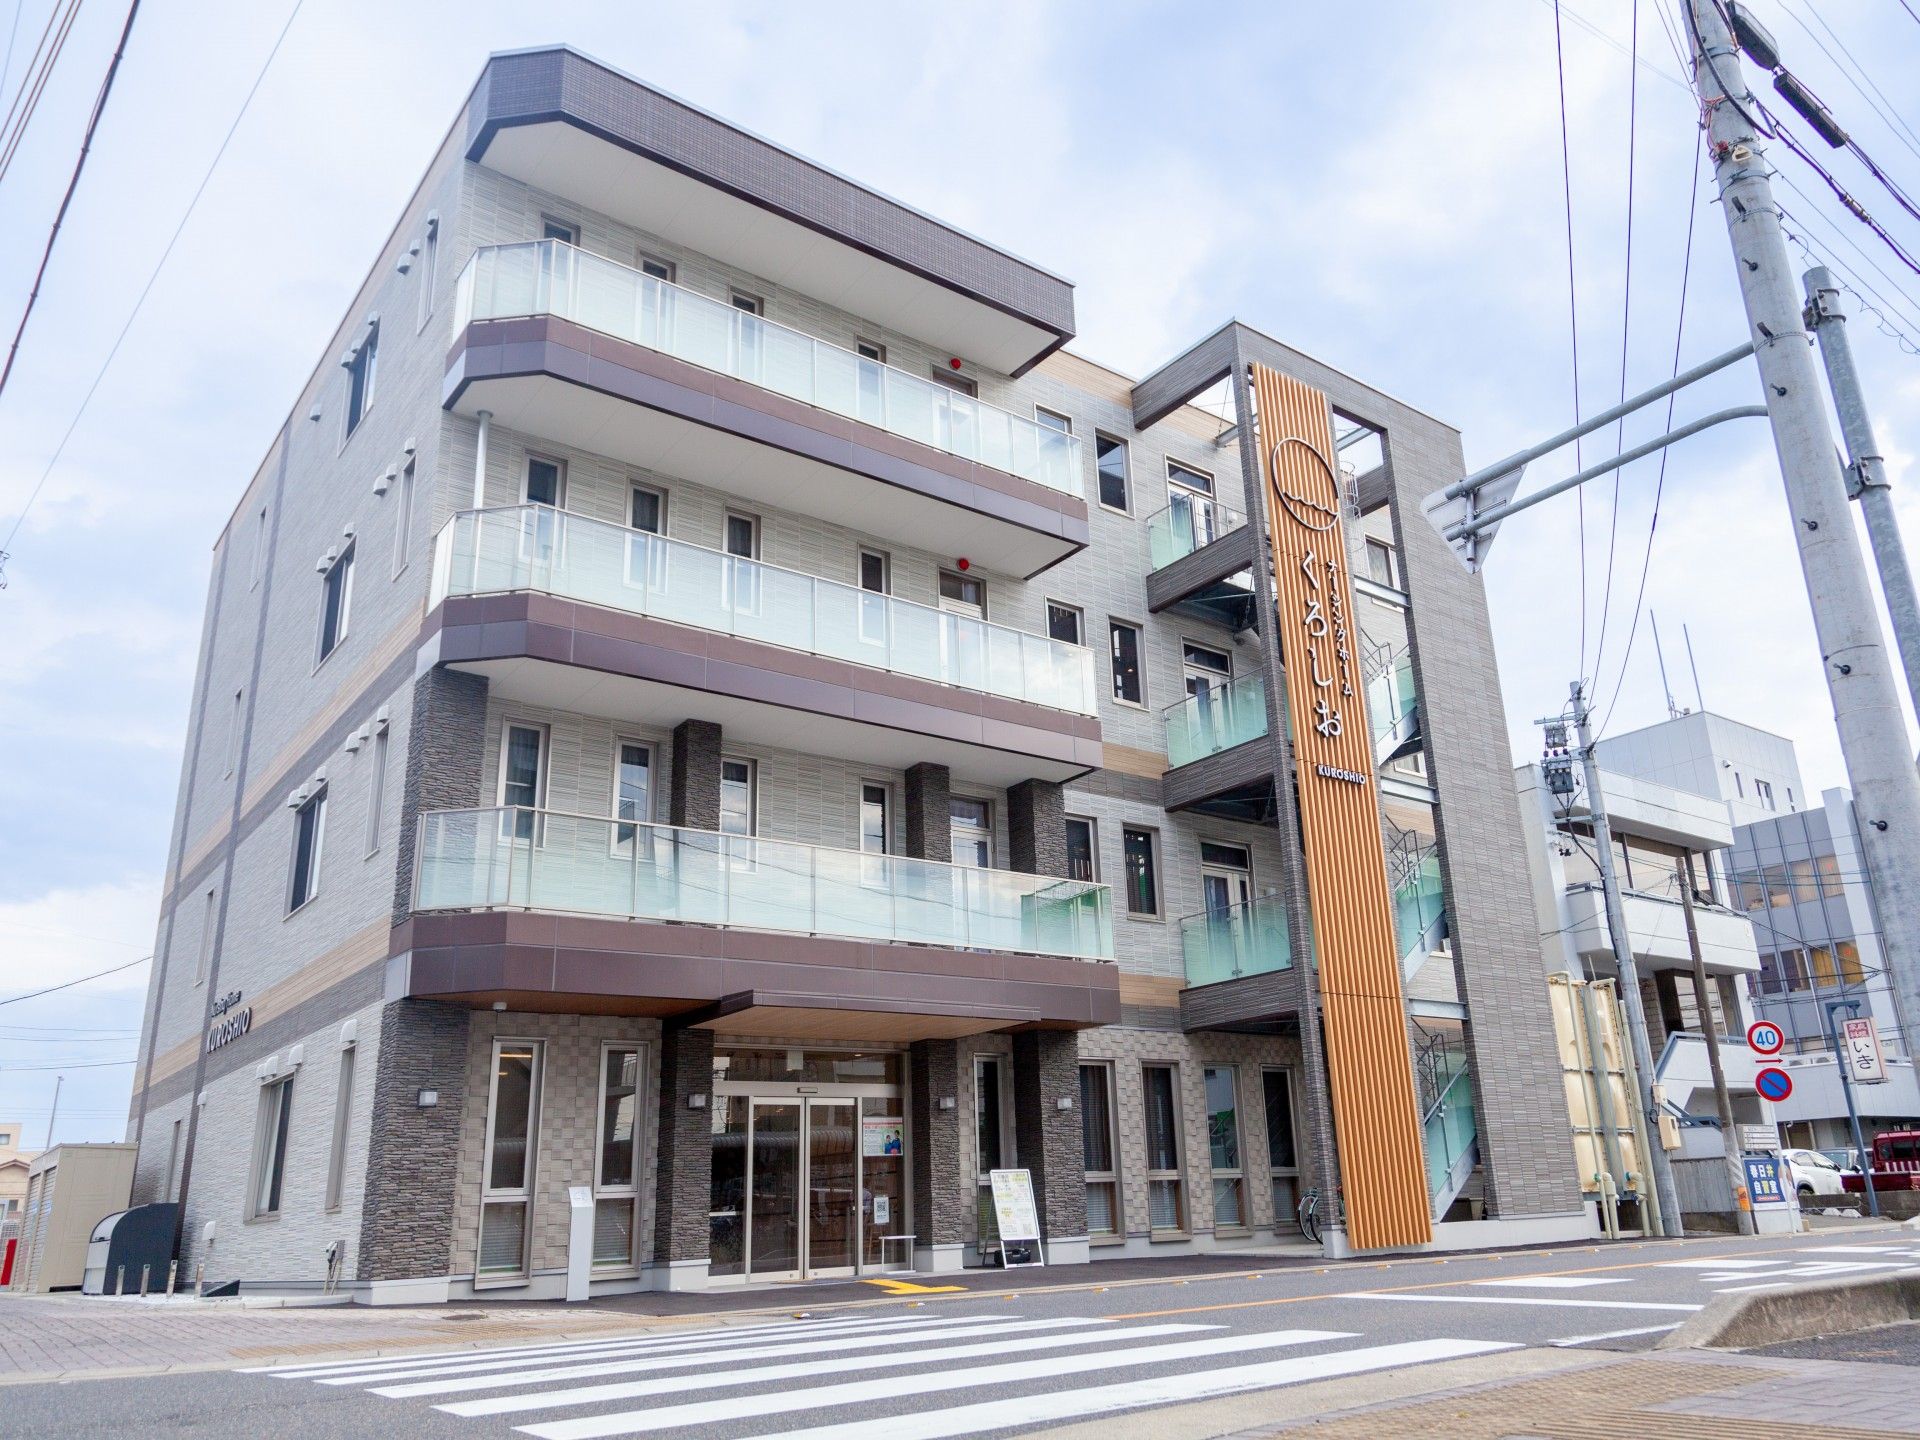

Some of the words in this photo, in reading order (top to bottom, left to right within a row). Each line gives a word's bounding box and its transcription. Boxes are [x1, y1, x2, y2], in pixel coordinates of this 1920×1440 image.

[1327, 560, 1354, 696] ナーシングホーム
[1302, 550, 1342, 738] くろしお
[1317, 764, 1366, 785] KUROSHIO
[1756, 1030, 1777, 1046] 40
[1853, 1041, 1874, 1070] いき
